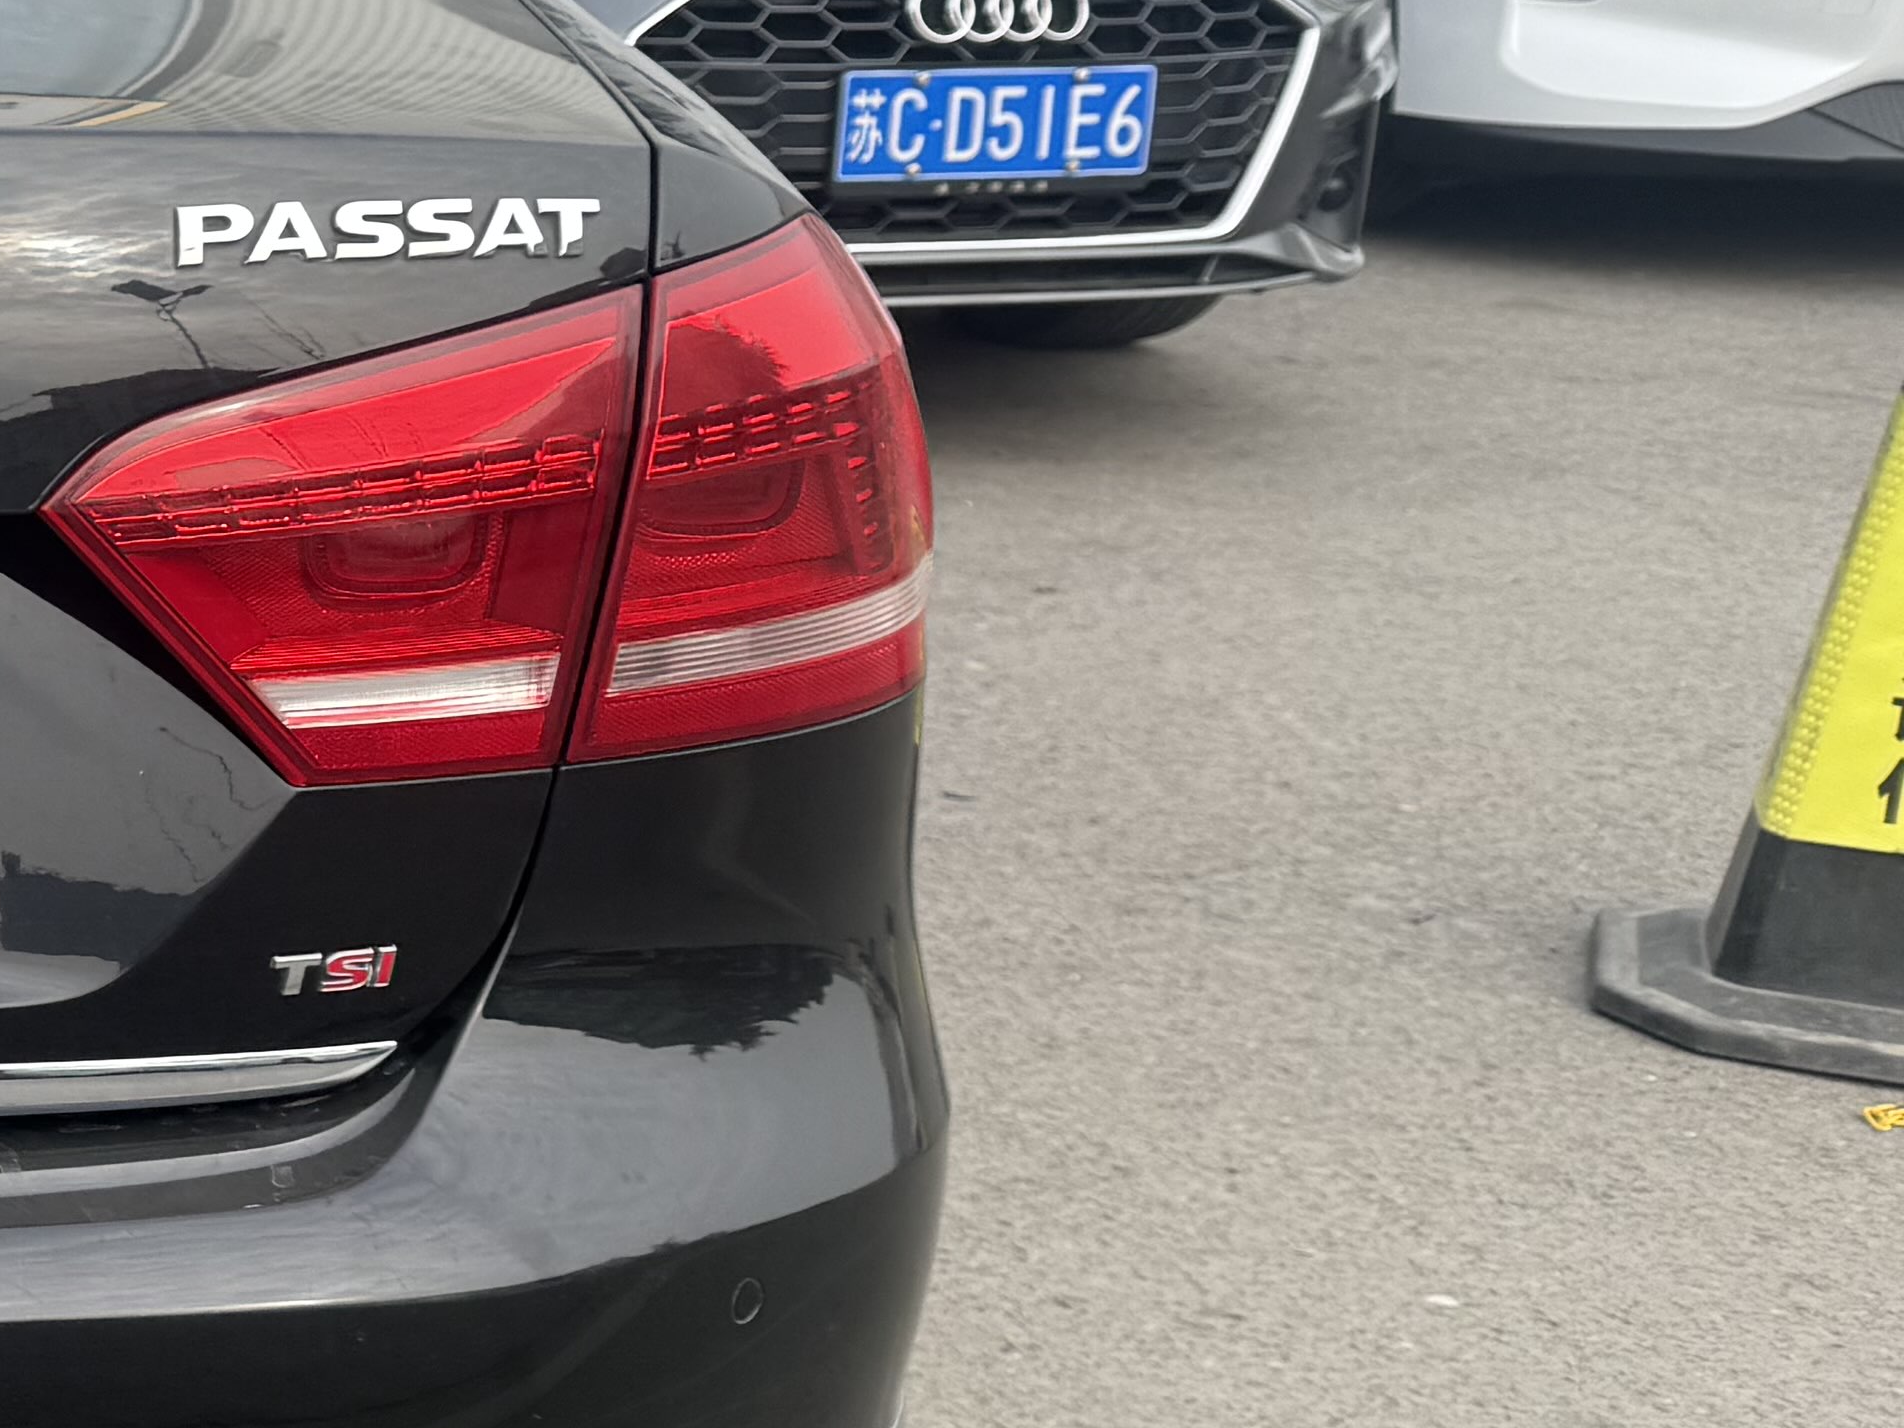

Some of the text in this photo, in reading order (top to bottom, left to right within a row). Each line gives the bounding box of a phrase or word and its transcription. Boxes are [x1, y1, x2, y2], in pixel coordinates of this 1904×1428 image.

[846, 84, 1143, 164] 苏C·D51E6
[174, 197, 601, 268] PASSAT
[269, 943, 398, 996] TSI
